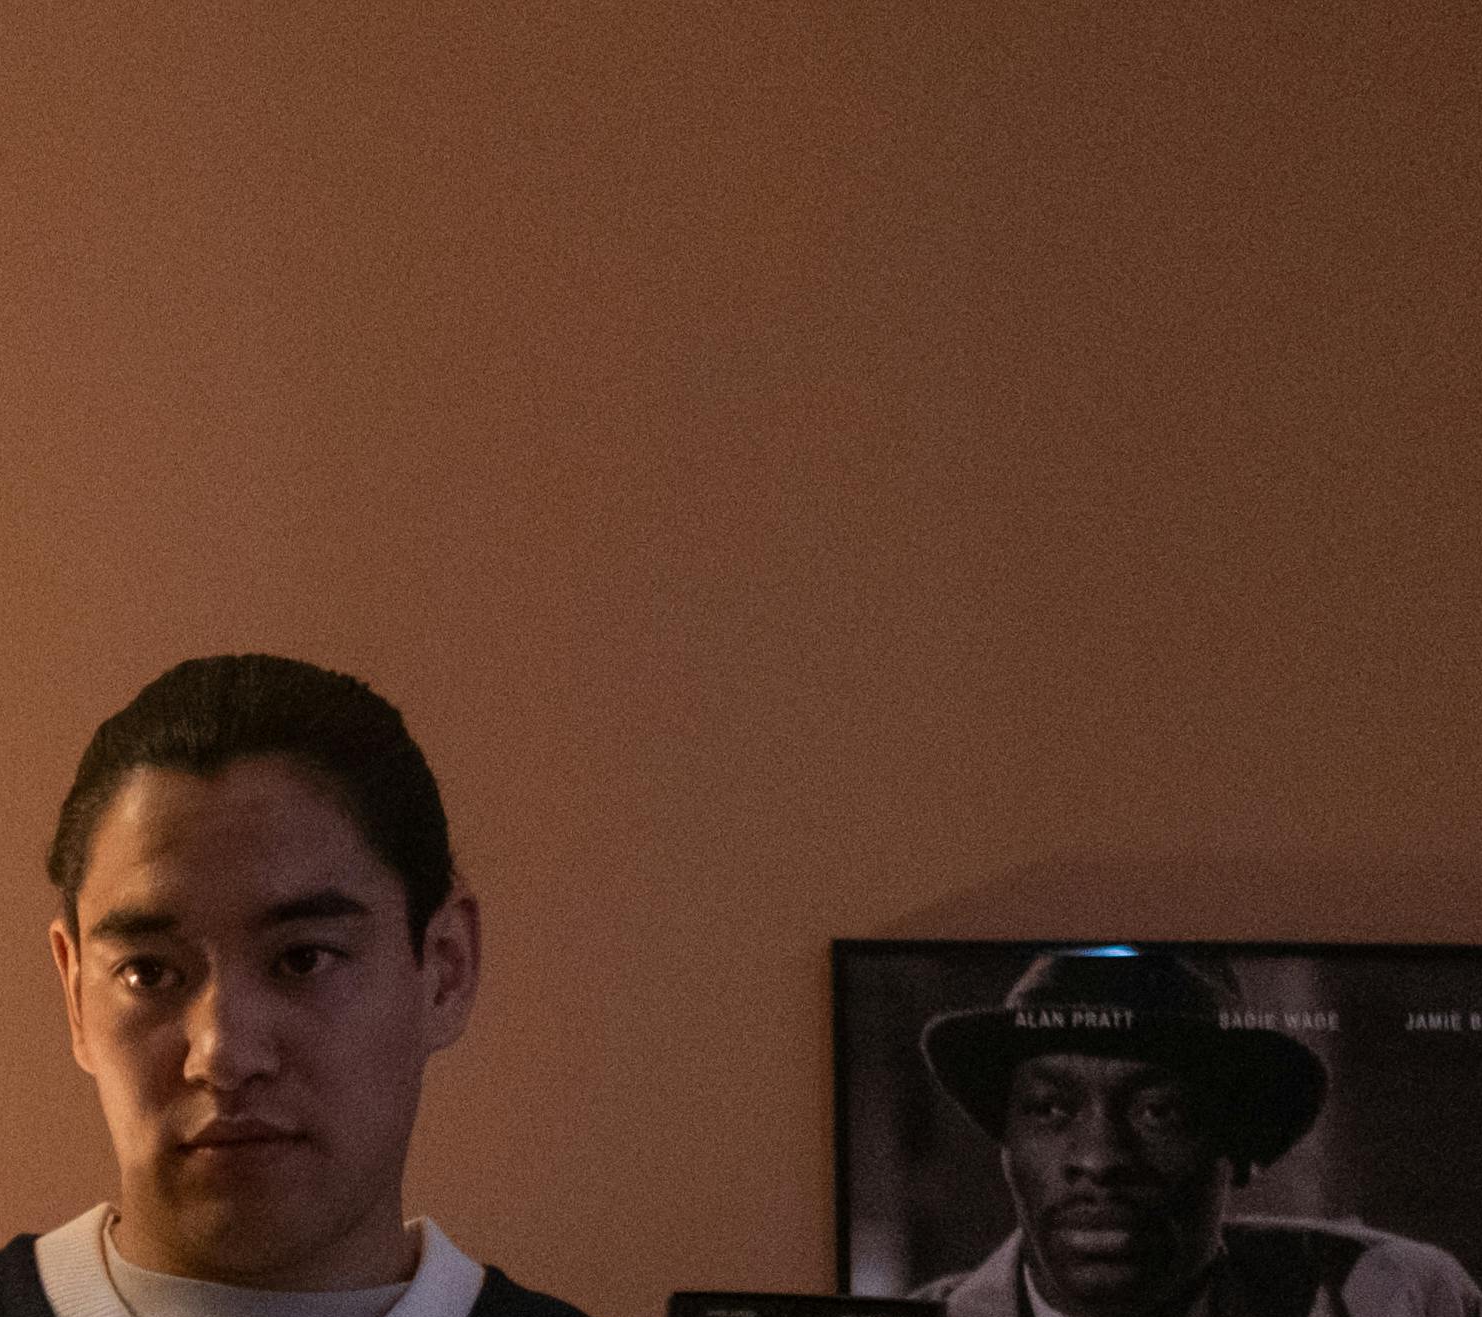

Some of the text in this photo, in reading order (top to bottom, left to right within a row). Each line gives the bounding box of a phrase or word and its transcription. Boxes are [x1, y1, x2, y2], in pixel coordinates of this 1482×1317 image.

[1015, 1009, 1135, 1030] ALAN PRATT
[1218, 1009, 1338, 1031] SADIE WADE
[1404, 1011, 1462, 1031] JAMIE
